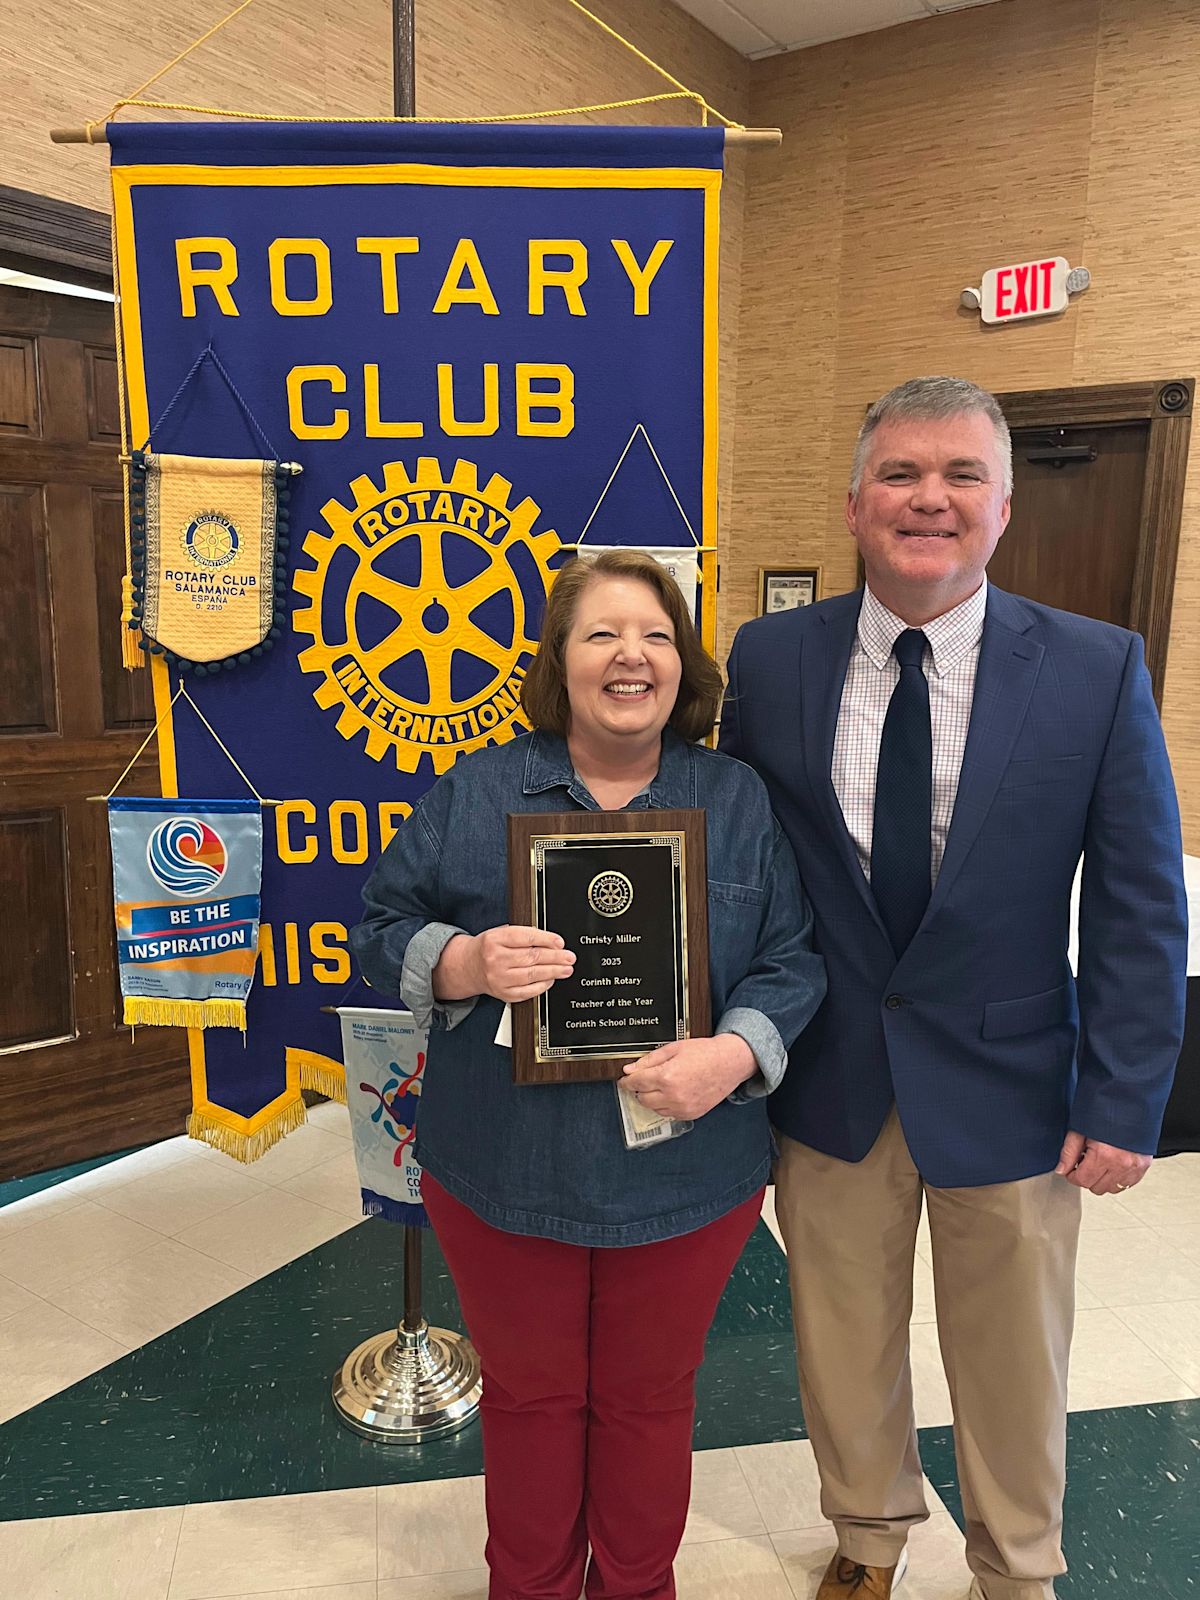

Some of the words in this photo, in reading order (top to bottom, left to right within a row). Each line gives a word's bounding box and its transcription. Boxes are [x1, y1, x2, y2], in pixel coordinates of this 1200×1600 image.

[175, 237, 674, 317] ROTARY
[995, 261, 1056, 318] EXIT
[287, 363, 575, 440] CLUB
[197, 515, 229, 526] ROTARY
[358, 492, 508, 543] ROTARY
[165, 570, 215, 583] ROTARY
[222, 575, 257, 586] CLUB
[175, 583, 246, 596] SALAMANCA
[191, 594, 228, 604] ESPAÑA
[169, 909, 191, 925] BE
[194, 903, 231, 922] THE
[128, 929, 245, 959] INSPIRATION
[579, 935, 613, 946] Christy
[616, 934, 642, 944] Miller
[601, 958, 621, 966] 2025
[215, 980, 242, 989] Rotary
[580, 977, 612, 987] Corinth
[613, 976, 642, 986] Rotary
[570, 1000, 604, 1009] Teacher
[606, 998, 616, 1007] of
[617, 997, 632, 1007] the
[634, 997, 654, 1006] Year
[565, 1020, 597, 1029] Corinth
[598, 1018, 627, 1027] School
[628, 1016, 660, 1026] District
[406, 1166, 422, 1177] RO
